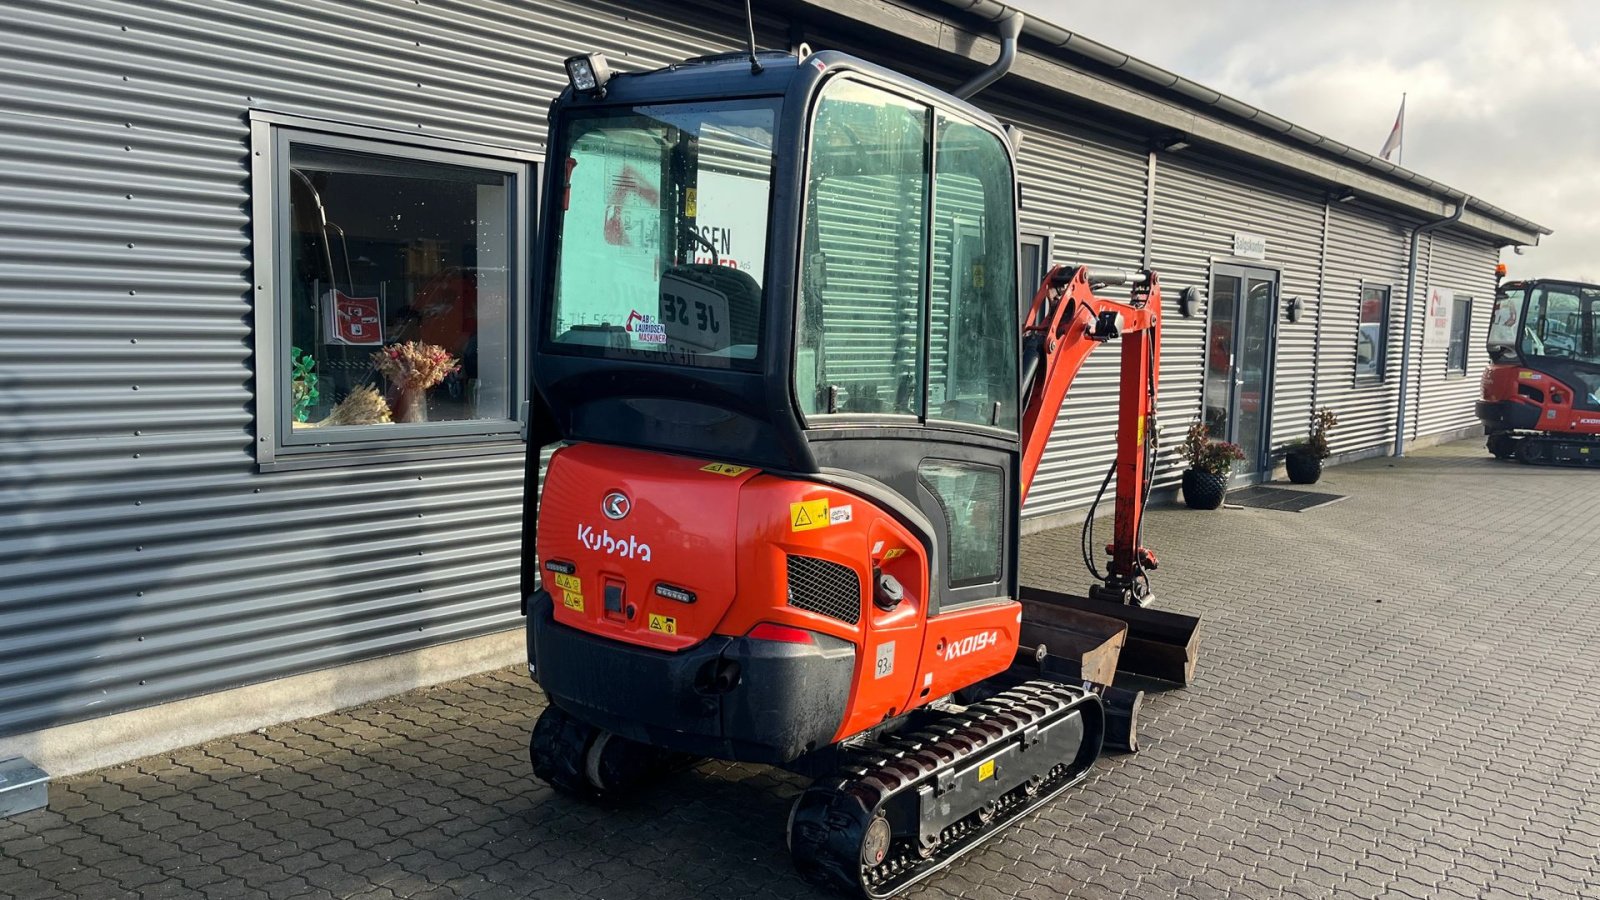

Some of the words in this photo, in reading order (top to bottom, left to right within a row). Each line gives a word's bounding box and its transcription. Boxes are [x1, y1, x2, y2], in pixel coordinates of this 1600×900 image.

[641, 314, 650, 324] AB
[635, 323, 665, 334] LAURIDSEN
[639, 333, 666, 343] MASKINER
[577, 523, 651, 562] Kubota
